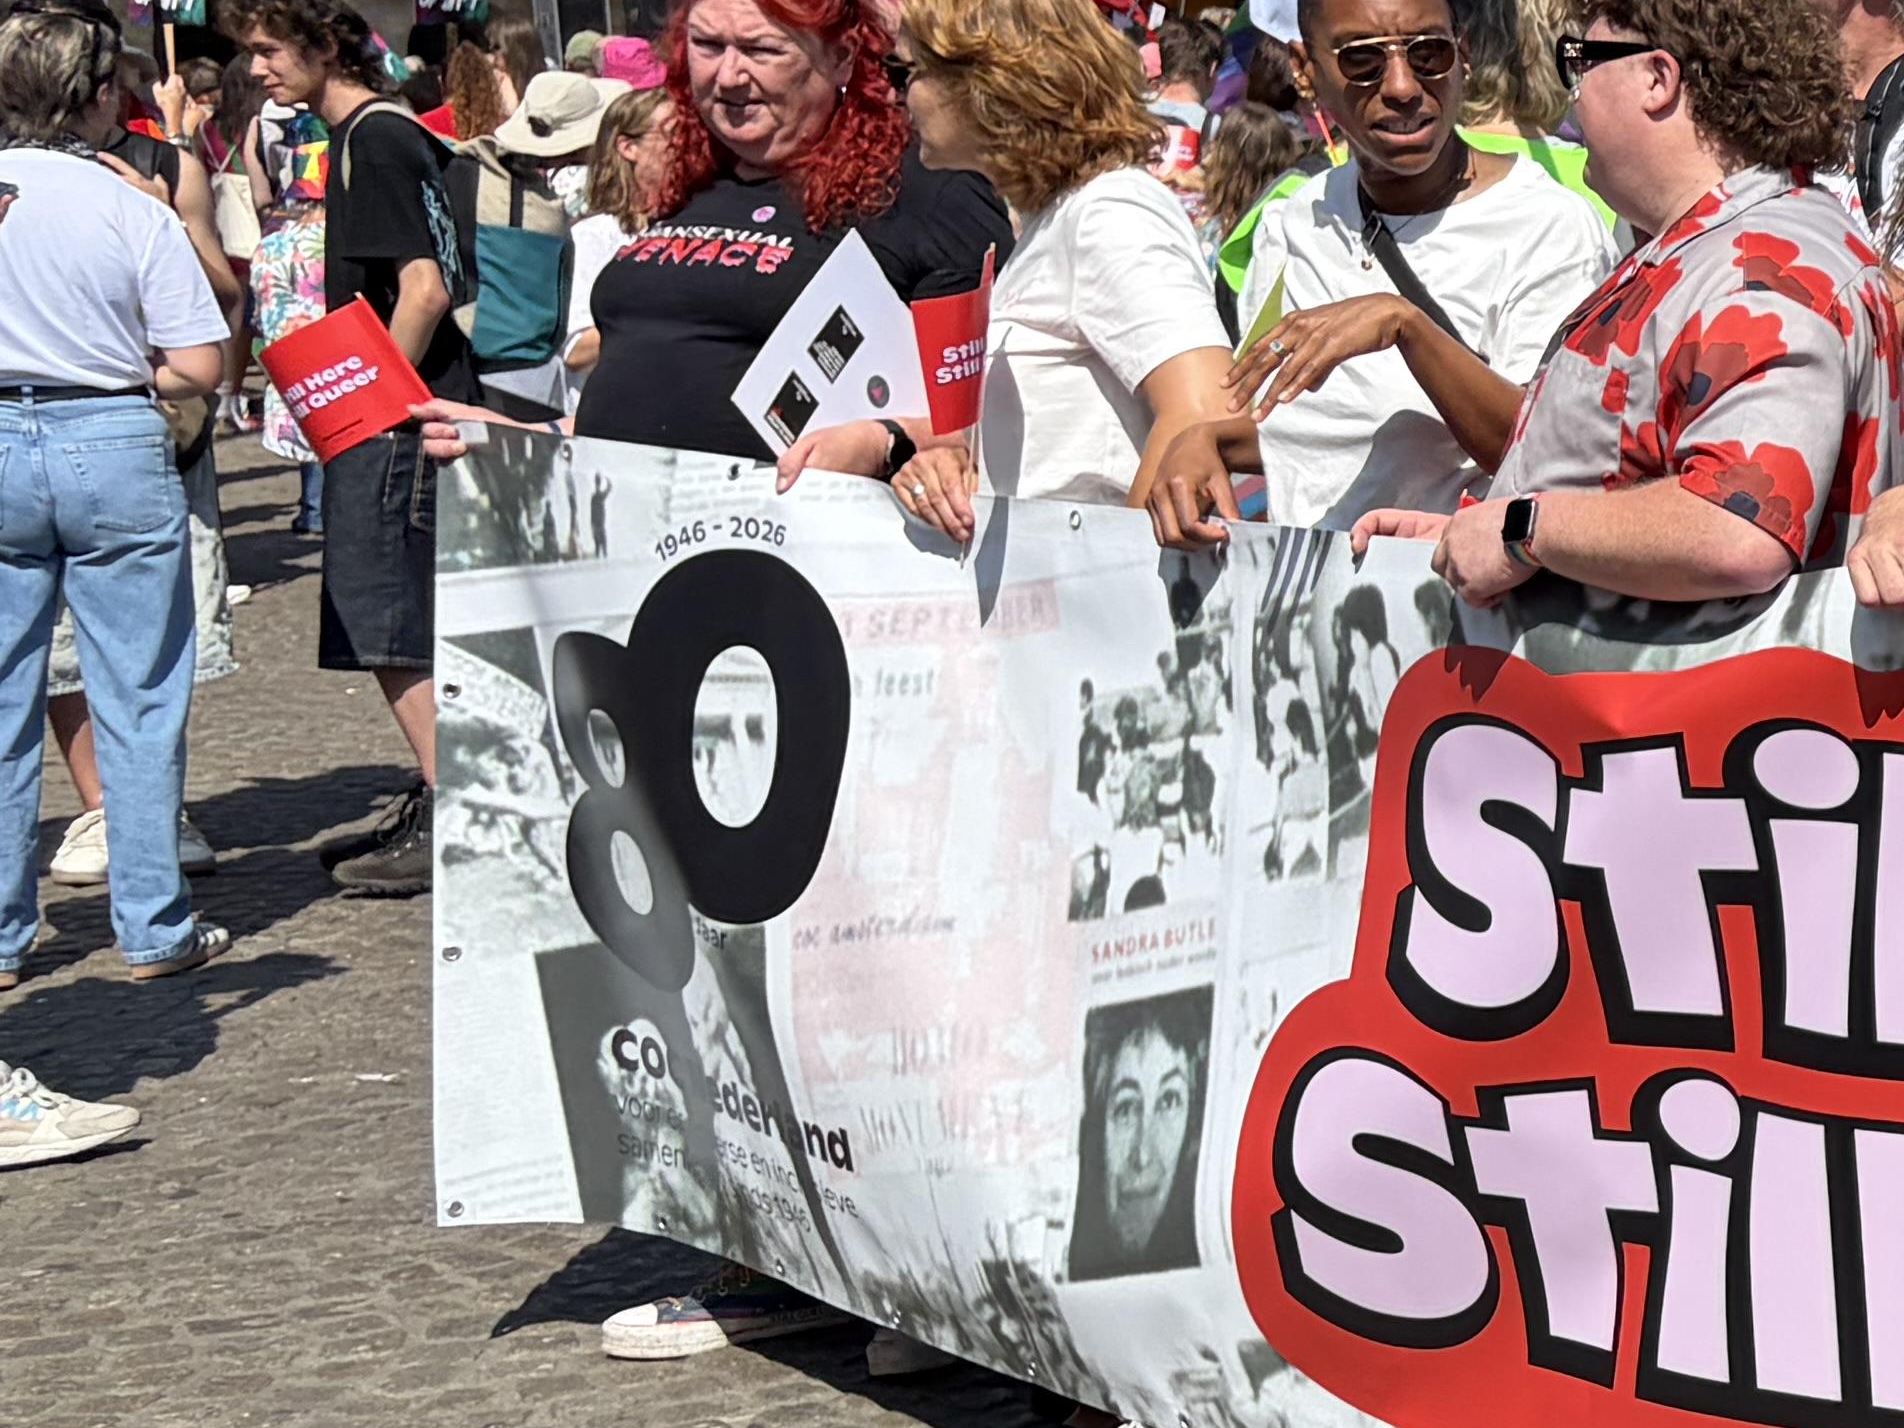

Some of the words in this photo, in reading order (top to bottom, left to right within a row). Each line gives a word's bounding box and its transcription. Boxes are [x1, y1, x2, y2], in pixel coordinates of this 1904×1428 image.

[303, 355, 364, 392] Here
[308, 365, 379, 409] Queer
[935, 357, 981, 384] Still
[655, 520, 706, 562] 1946
[729, 516, 787, 547] 2026
[1091, 932, 1160, 965] SANDRA
[612, 1028, 667, 1079] CO
[617, 1132, 687, 1170] samen
